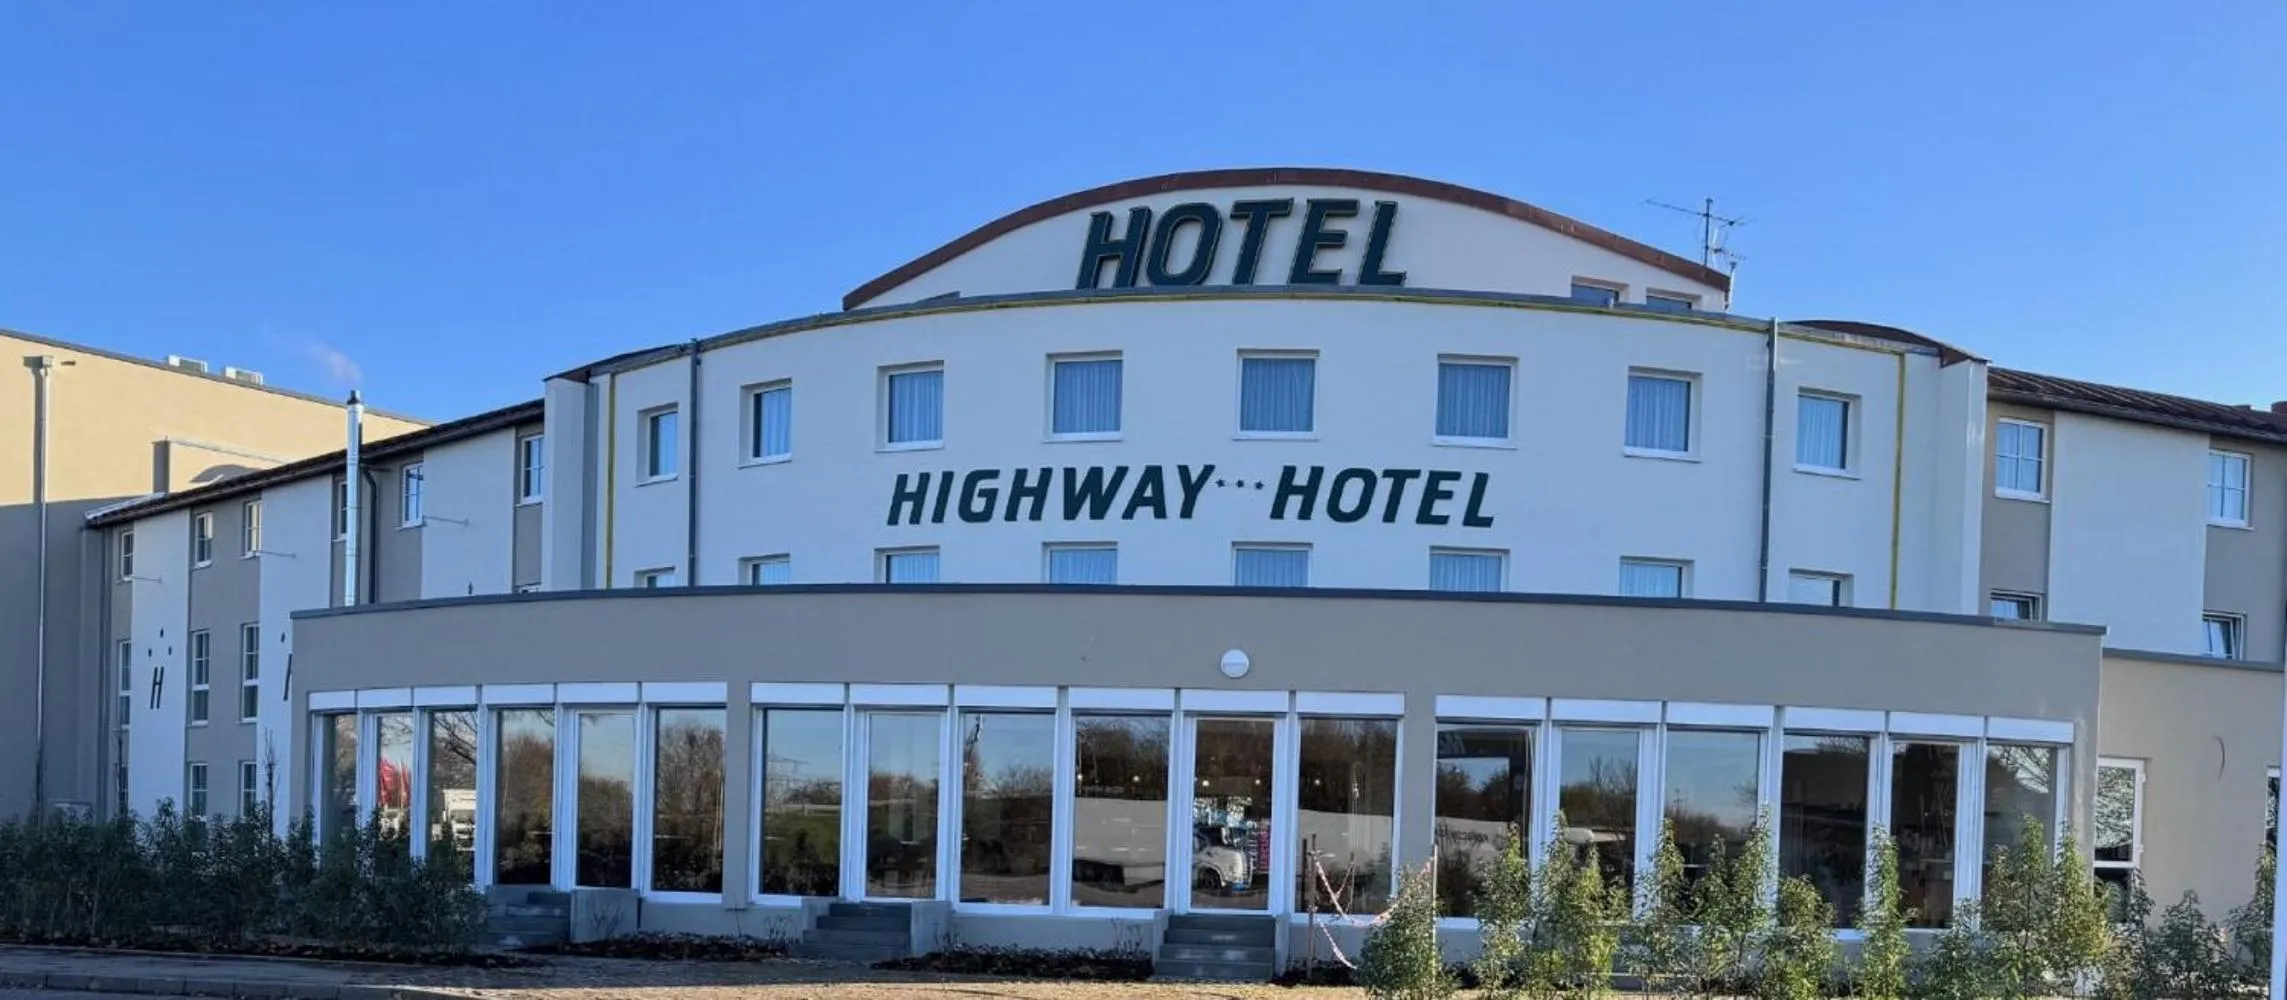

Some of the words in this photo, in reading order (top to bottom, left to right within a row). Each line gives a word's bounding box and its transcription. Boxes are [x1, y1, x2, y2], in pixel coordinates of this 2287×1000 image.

[1076, 198, 1407, 289] HOTEL
[887, 464, 1214, 526] HIGHWAY
[1269, 465, 1495, 528] HOTEL
[150, 666, 165, 710] H
